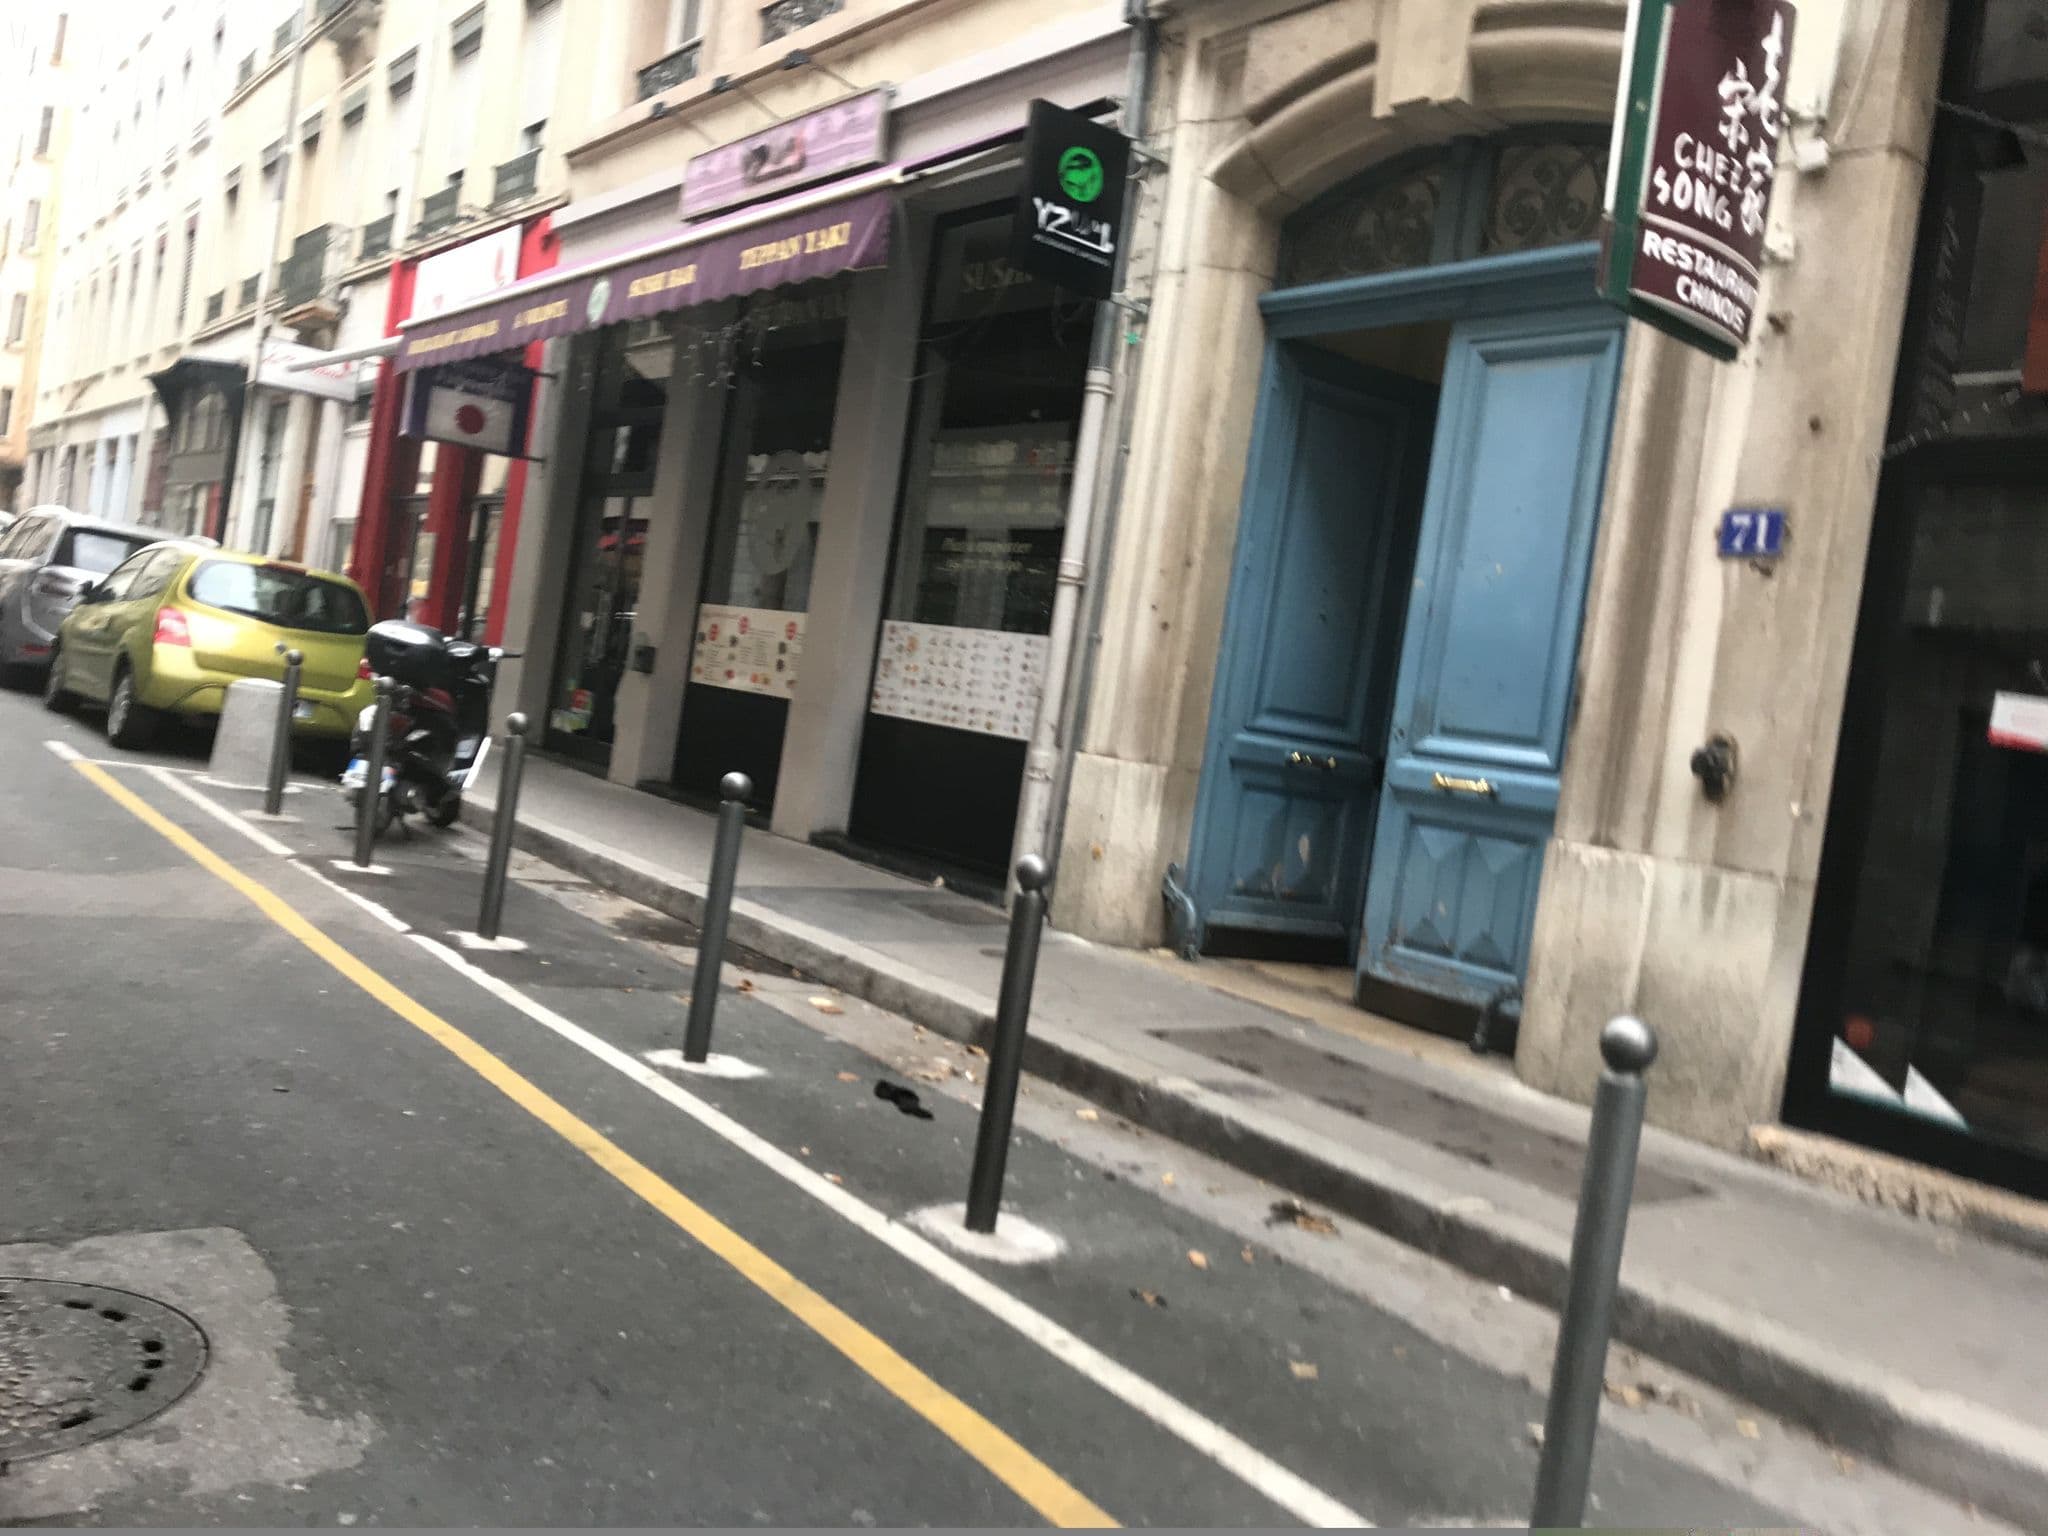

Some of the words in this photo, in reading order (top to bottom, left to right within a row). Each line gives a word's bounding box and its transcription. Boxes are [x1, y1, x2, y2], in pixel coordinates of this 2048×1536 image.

[1674, 132, 1743, 194] CHEZ
[1653, 165, 1733, 232] SONG
[1731, 513, 1769, 554] 71
